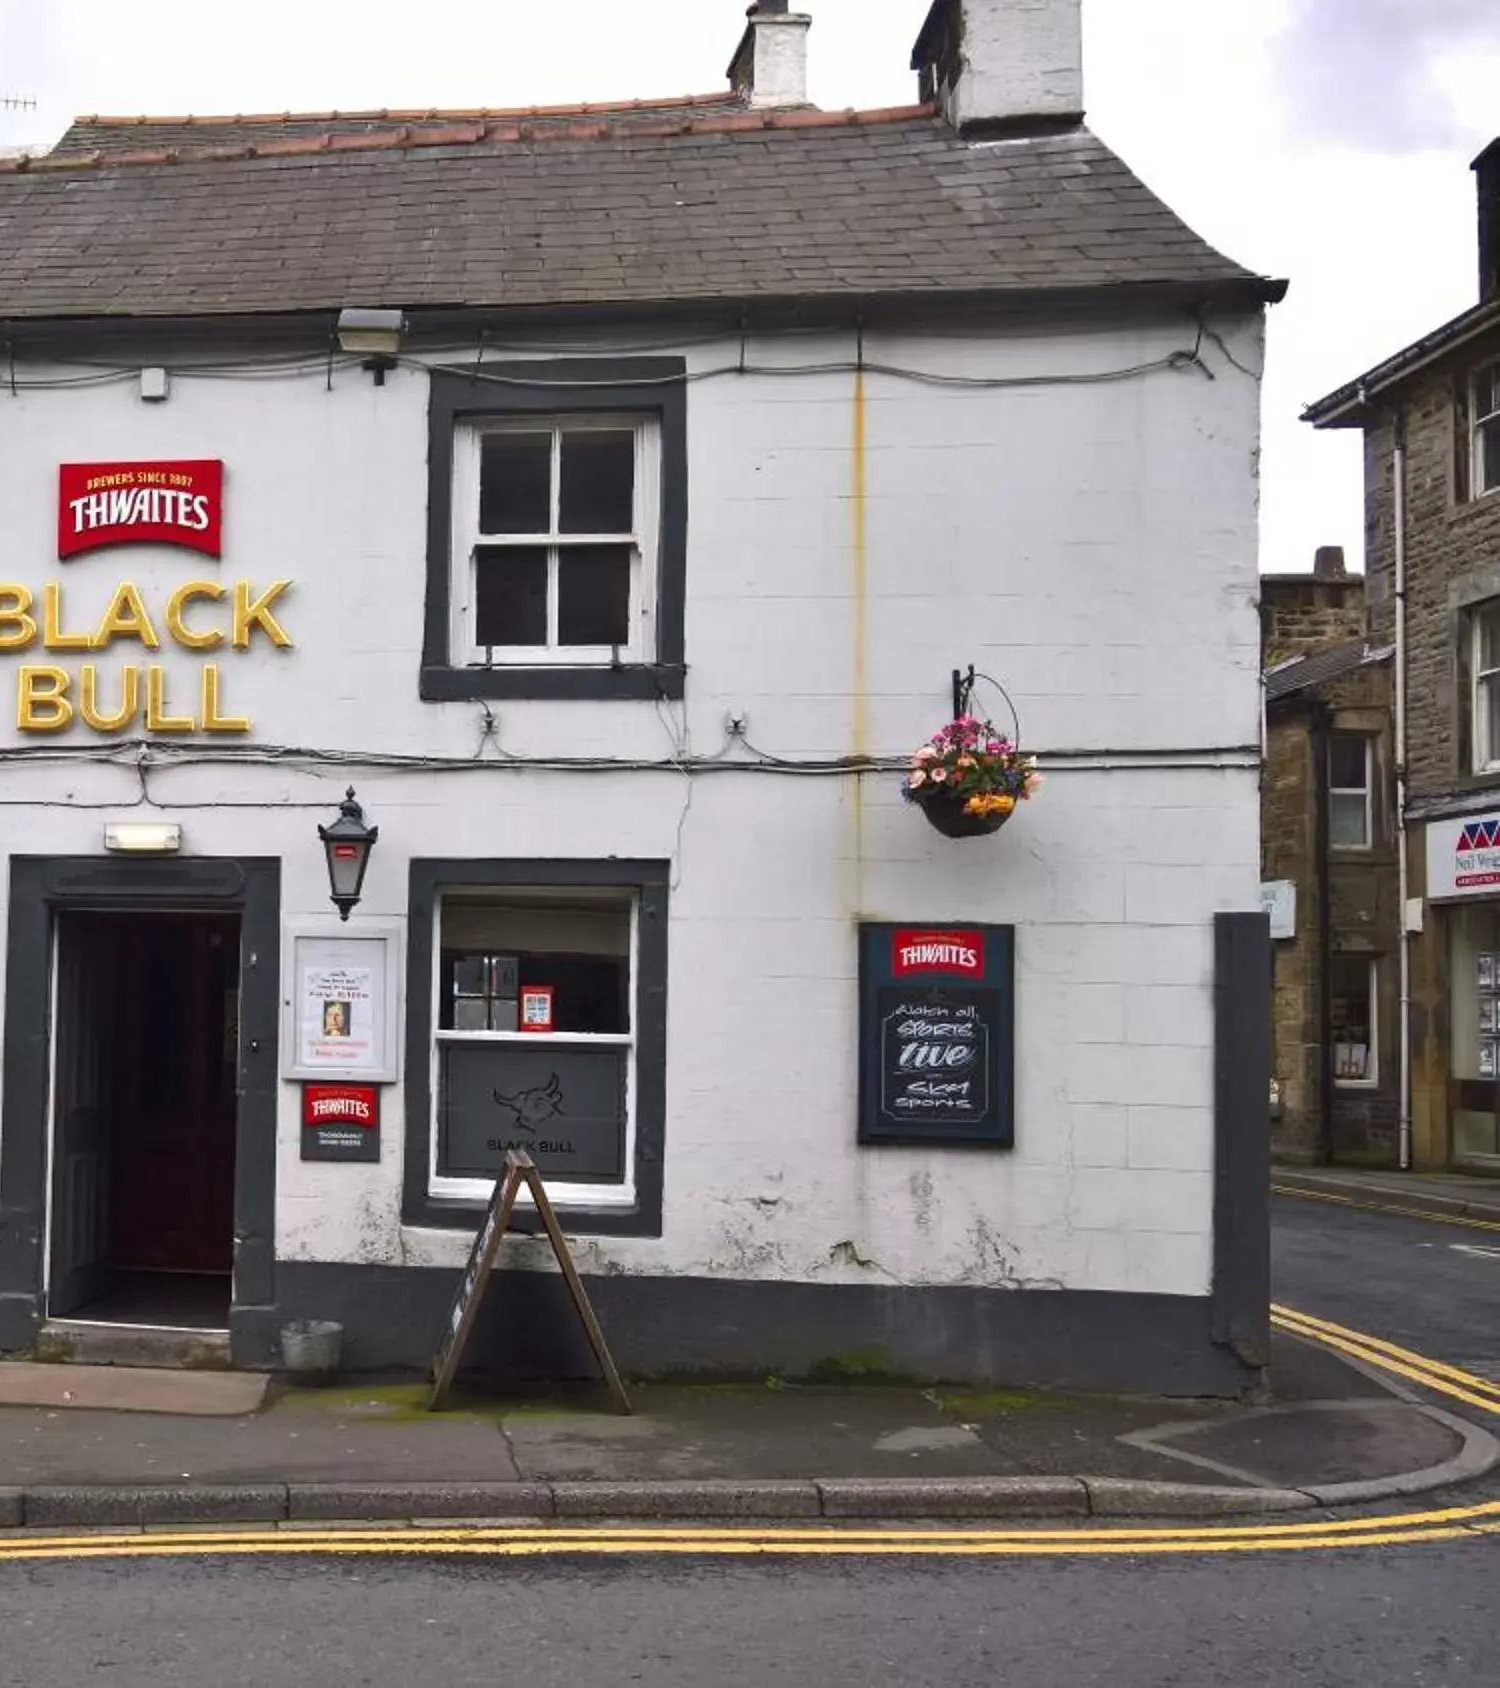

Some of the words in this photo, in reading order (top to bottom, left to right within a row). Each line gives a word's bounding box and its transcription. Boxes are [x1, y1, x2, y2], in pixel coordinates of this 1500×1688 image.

[87, 472, 135, 490] BREWERS
[137, 472, 166, 485] SINCE
[70, 487, 209, 533] THWAITES
[17, 664, 253, 732] BULL
[900, 943, 977, 967] THWAITES
[311, 1098, 369, 1118] THWAITES
[488, 1139, 535, 1152] BLACK
[540, 1141, 575, 1153] BULL
